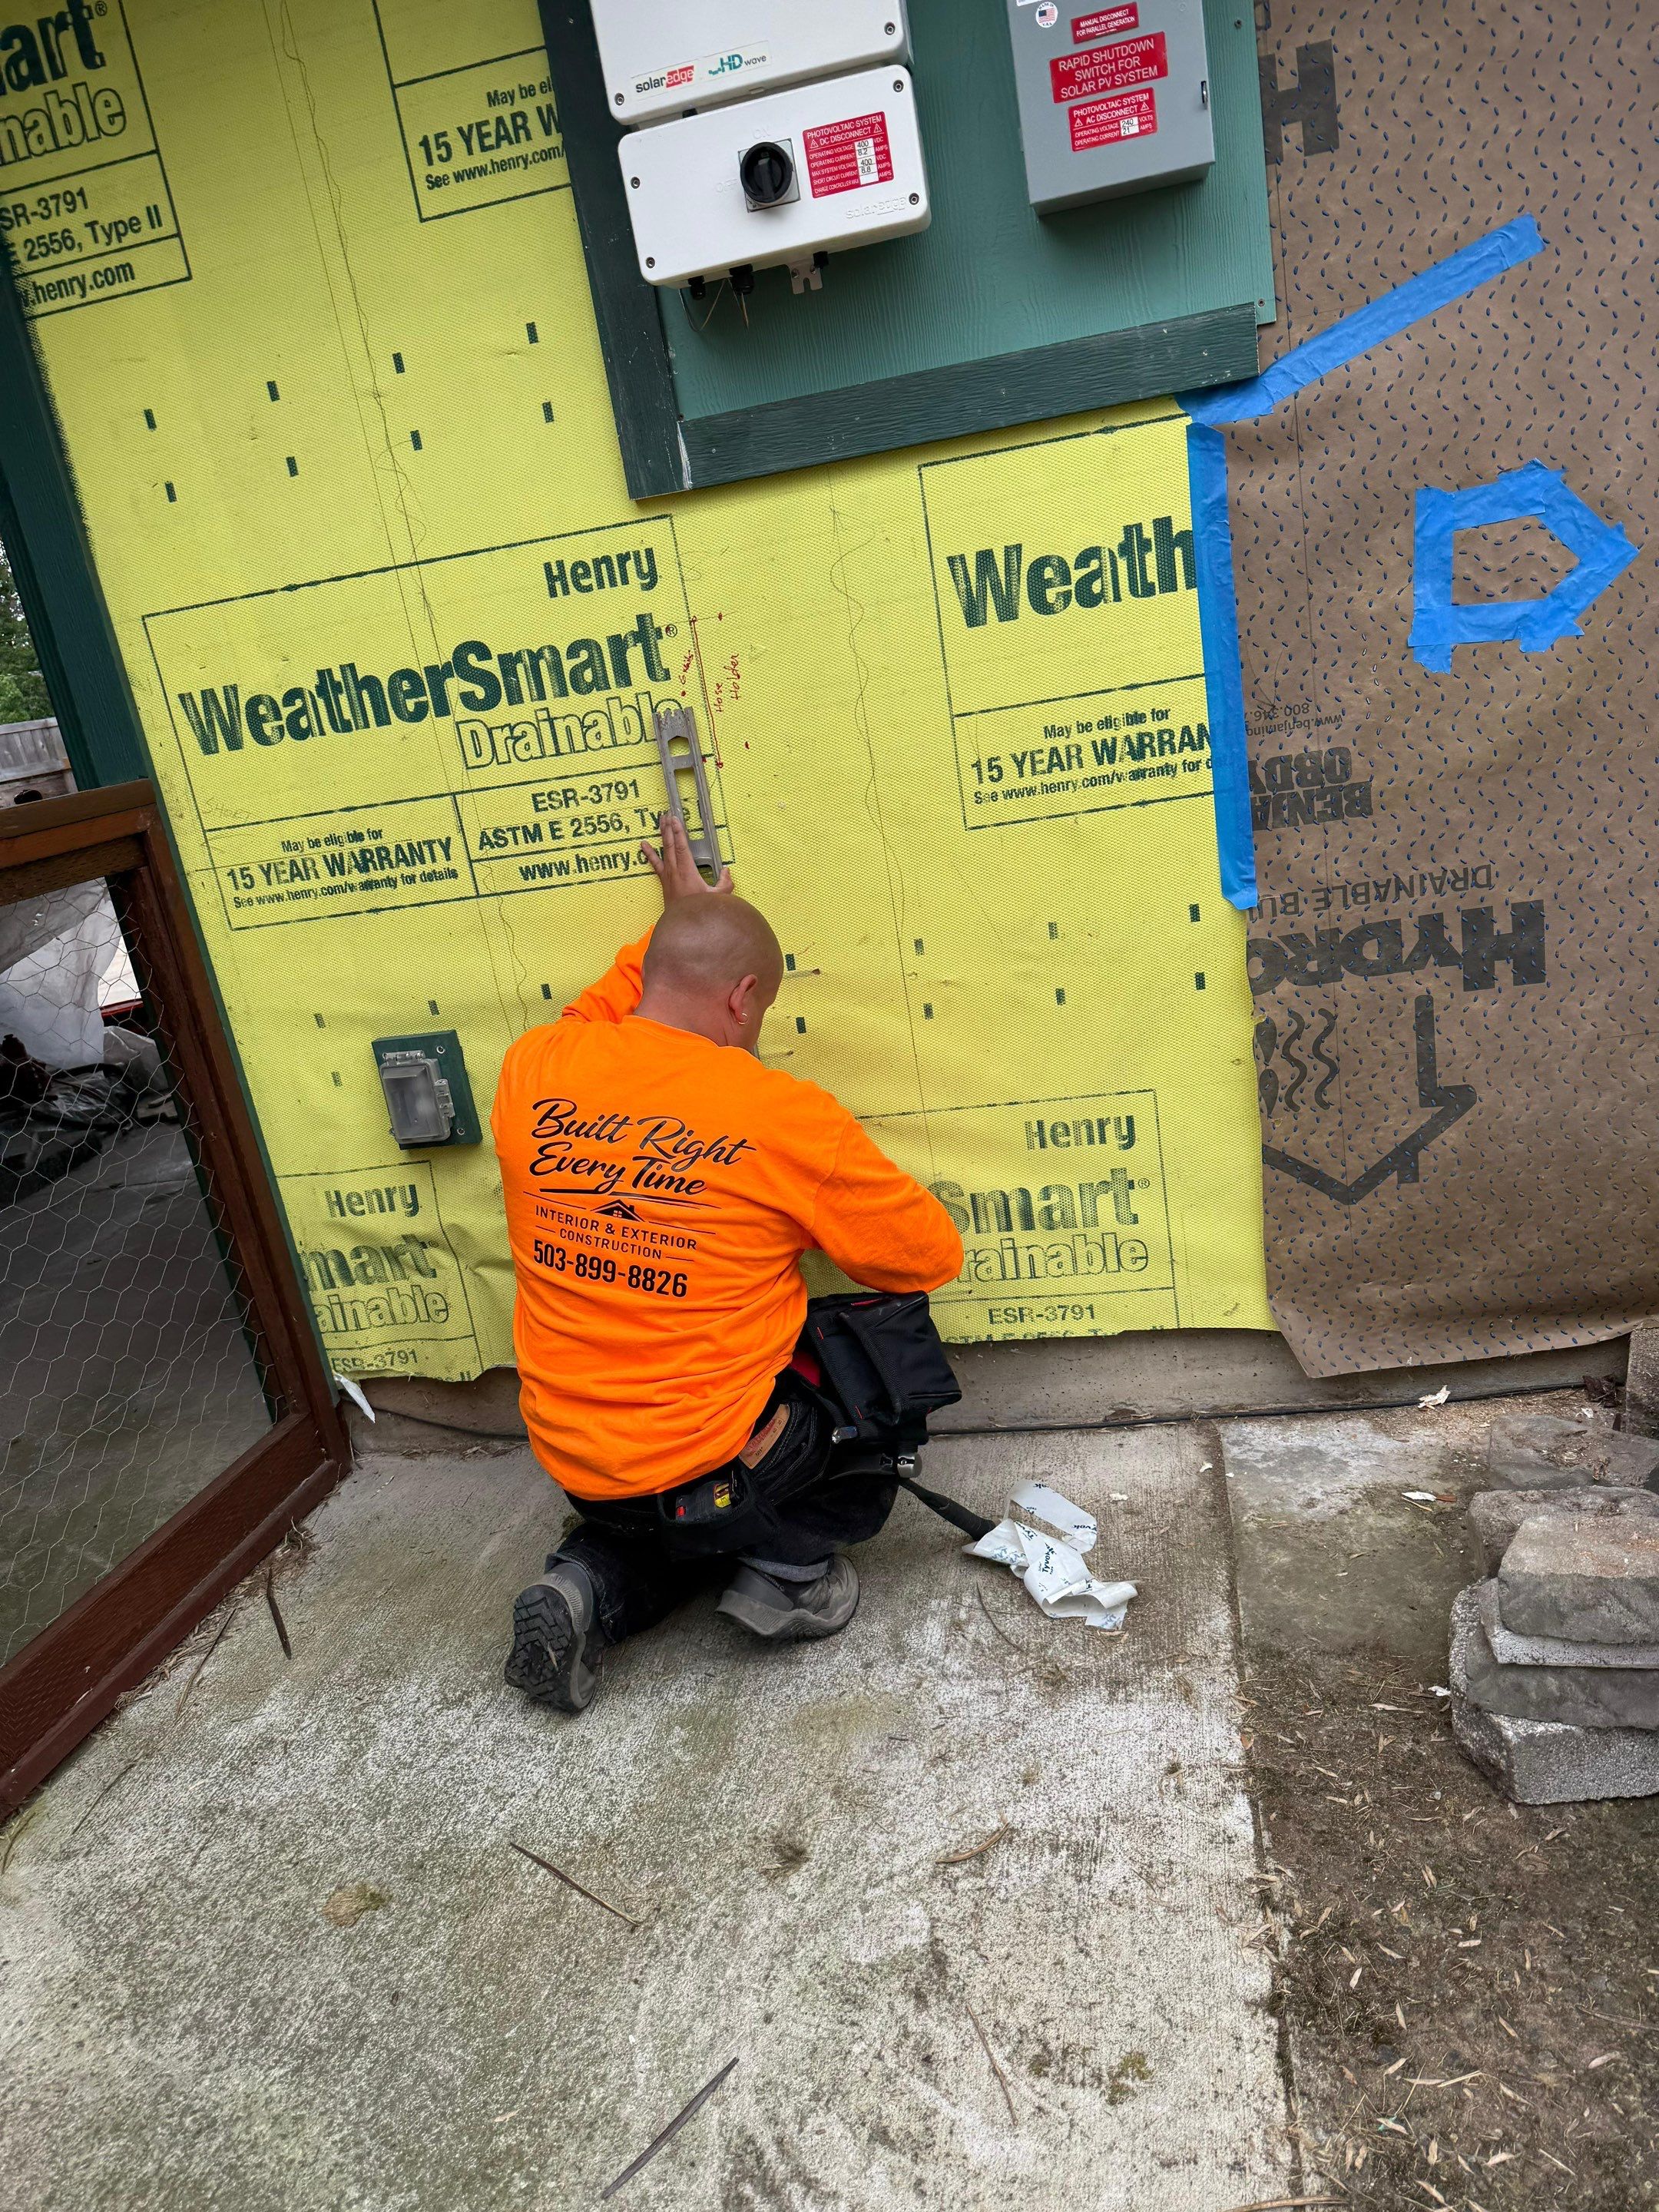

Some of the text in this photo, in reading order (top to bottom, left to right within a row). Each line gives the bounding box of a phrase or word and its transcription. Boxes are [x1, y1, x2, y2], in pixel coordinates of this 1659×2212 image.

[1080, 8, 1129, 28] MANUAL DISCONNECT
[1086, 25, 1106, 35] PARALLEL
[1108, 16, 1135, 29] GENERATION
[720, 54, 767, 72] HD wave
[1059, 38, 1154, 71] RAPID SHUTDOWN
[1075, 56, 1141, 81] SWITCH FOR
[635, 65, 694, 93] solaredge
[1061, 65, 1158, 98] SOLAR PV SYSTEM
[486, 89, 515, 108] May
[518, 84, 536, 100] be
[1074, 92, 1149, 118] PHOTOVOLTAIC SYSTEM
[807, 114, 882, 139] PHOTOVOLTAIC SYSTEM
[1075, 127, 1099, 137] OPERATING
[1099, 123, 1118, 133] VOLTAGE
[1086, 104, 1137, 124] AC DISCONNECT
[419, 131, 453, 167] 15
[456, 111, 532, 156] YEAR
[809, 149, 834, 160] OPERATING
[834, 144, 854, 154] VOLTAGE
[857, 140, 869, 148] 400
[820, 126, 871, 146] DC DISCONNECT
[1075, 136, 1099, 146] OPERATING
[1099, 131, 1120, 141] CURRENT
[810, 158, 835, 168] OPERATING
[835, 152, 856, 163] CURRENT
[861, 165, 871, 174] 8.8
[426, 173, 450, 190] See
[24, 228, 83, 262] 2556,
[84, 216, 141, 247] Type
[146, 204, 163, 229] II
[544, 546, 659, 598] Henry
[946, 516, 1197, 628] Weath
[724, 654, 741, 701] Holder
[714, 683, 723, 712] Hose
[1044, 708, 1170, 740] May be eligible for
[972, 757, 1003, 785] 15
[1010, 743, 1083, 780] YEAR
[531, 778, 640, 813] ESR-3791
[974, 790, 998, 805] See
[1182, 759, 1201, 773] for
[281, 828, 383, 853] May be eligible for
[478, 823, 544, 850] ASTM
[550, 821, 565, 840] E
[571, 812, 631, 838] 2556,
[227, 836, 452, 891] 15 YEAR WARRANTY
[233, 866, 459, 909] See www.henry.com/warranty for details
[1312, 864, 1492, 912] DRAINABLE
[1246, 899, 1545, 996] HYDRO
[531, 1098, 757, 1172] Built Right
[1025, 1114, 1136, 1151] Henry
[529, 1141, 707, 1195] Every Time
[325, 1183, 420, 1218] Henry
[536, 1204, 697, 1250] INTERIOR & EXTERIOR
[560, 1228, 662, 1260] CONSTRUCTION
[534, 1240, 688, 1298] 503-899-8826
[988, 1304, 1095, 1325] ESR-3791
